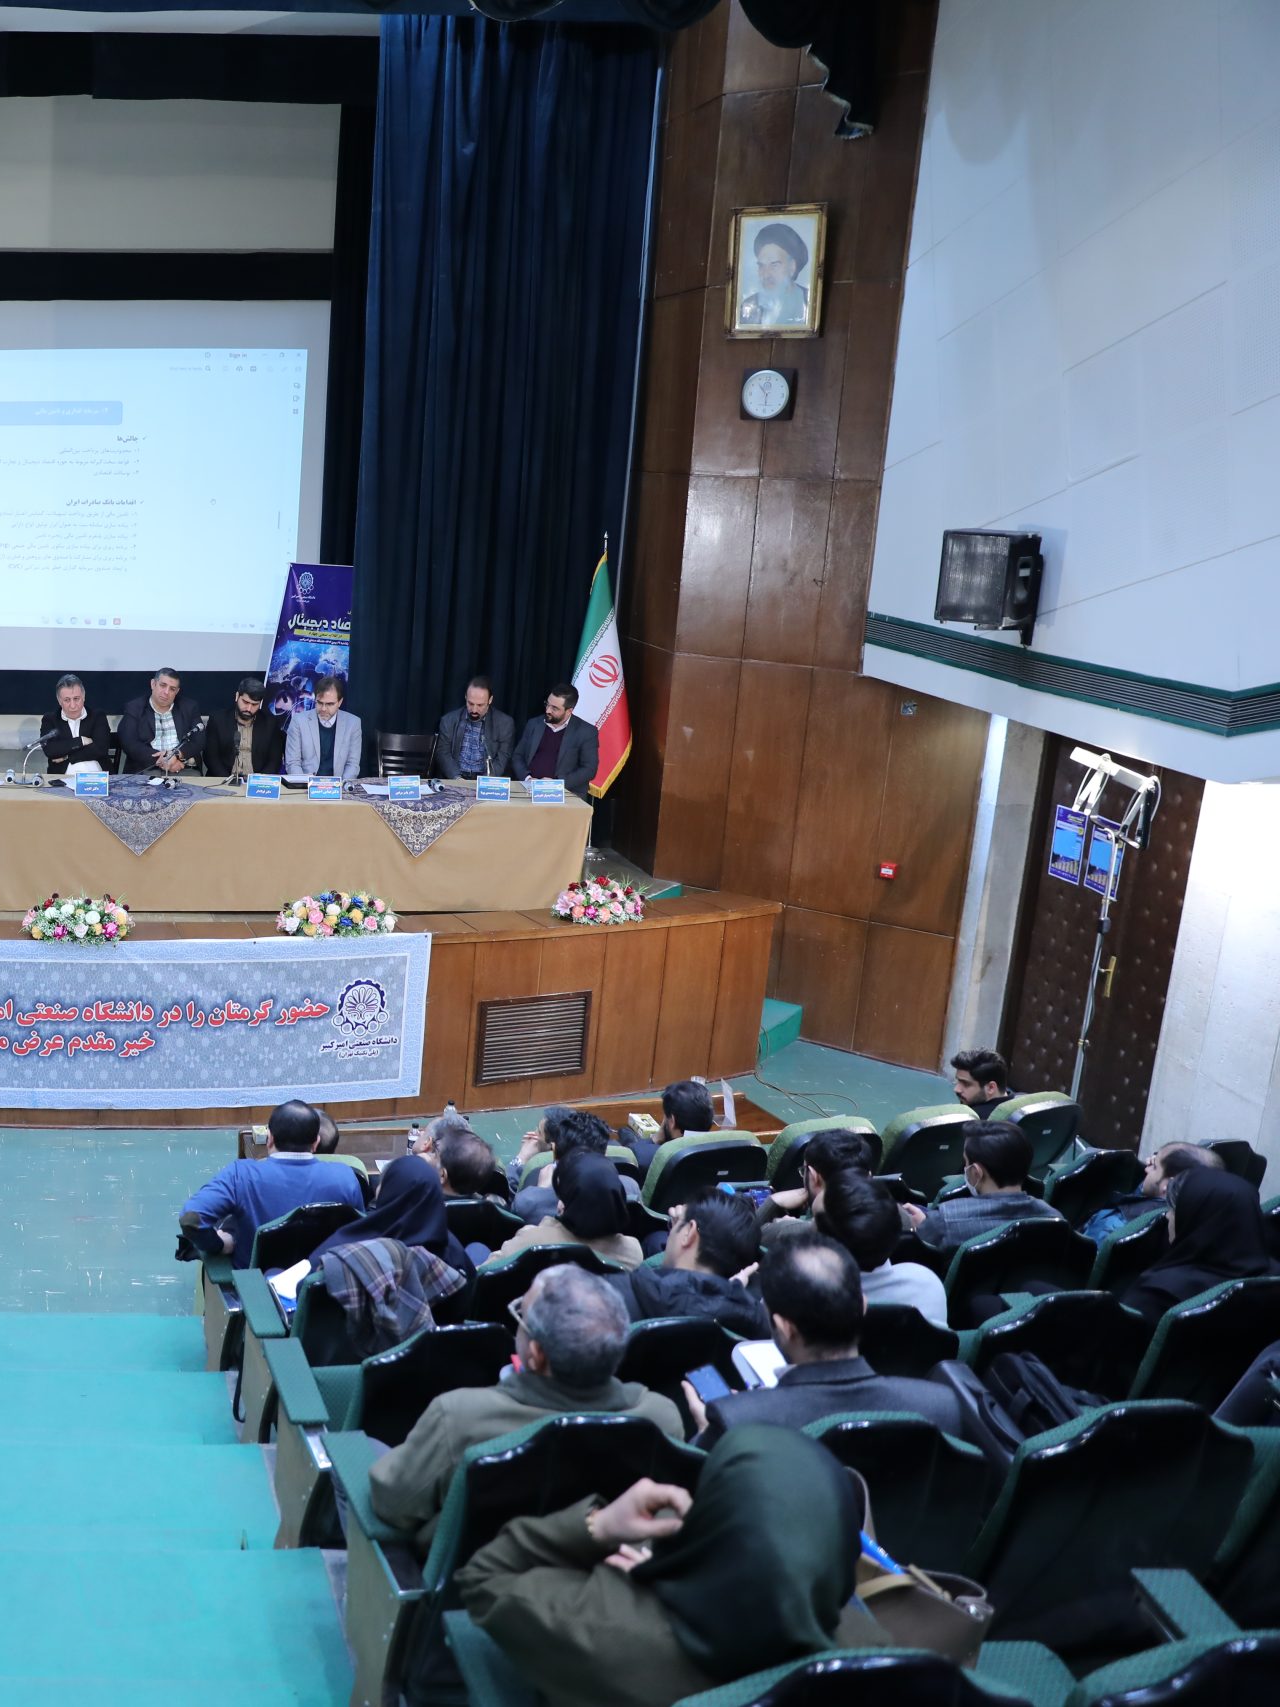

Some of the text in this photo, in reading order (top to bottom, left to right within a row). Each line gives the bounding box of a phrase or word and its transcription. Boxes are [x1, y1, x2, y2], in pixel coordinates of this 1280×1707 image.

[287, 613, 328, 631] دیجیتال
[16, 1001, 79, 1026] صنعتی
[82, 1000, 155, 1023] دانشگاه
[156, 1003, 182, 1028] در
[185, 1000, 205, 1027] را
[208, 999, 274, 1027] گرمتان
[275, 998, 331, 1026] حضور
[12, 1030, 64, 1057] عرض
[67, 1031, 116, 1057] مقدم
[118, 1030, 156, 1057] خیر
[349, 1040, 371, 1049] صنعتی
[372, 1036, 398, 1045] دانشگاه
